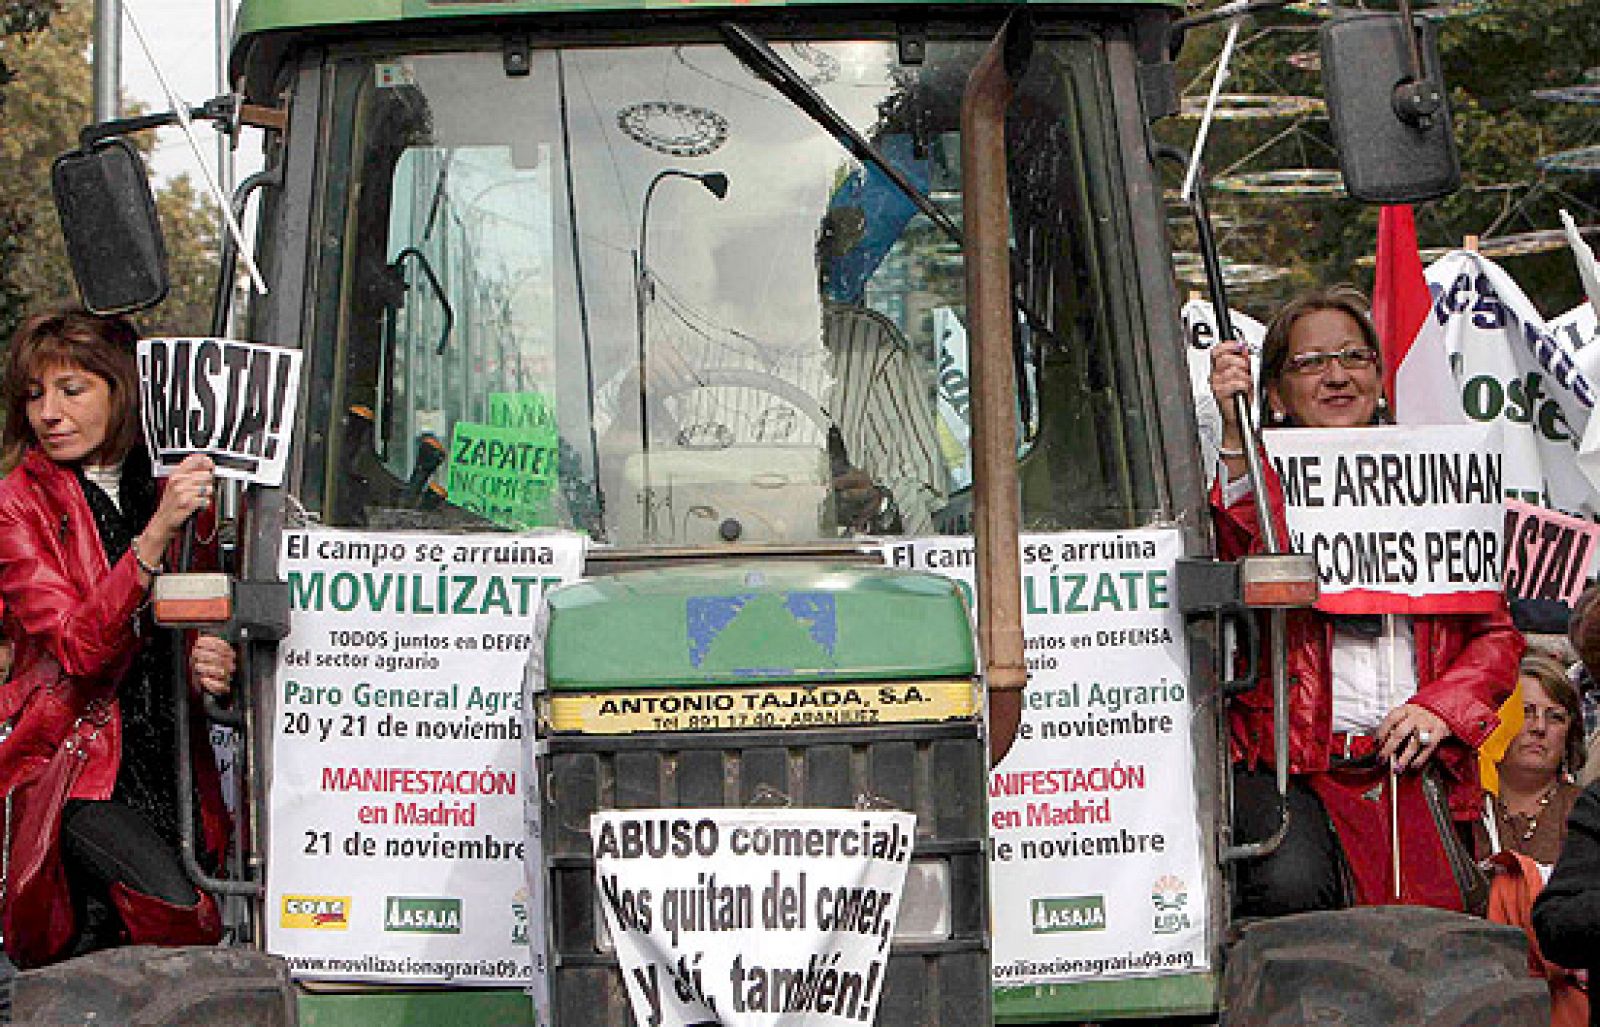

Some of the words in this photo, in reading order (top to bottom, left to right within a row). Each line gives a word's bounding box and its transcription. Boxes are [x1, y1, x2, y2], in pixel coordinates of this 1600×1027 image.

[141, 340, 292, 461] ¡BASTA!
[1334, 453, 1501, 507] ARRUINAN
[287, 535, 309, 560] El
[317, 541, 405, 567] campo
[415, 543, 444, 564] se
[453, 541, 554, 565] arruina
[1024, 543, 1053, 563] se
[1062, 535, 1156, 562] arruina
[1312, 531, 1417, 586] COMES
[1425, 530, 1499, 583] PEOR
[328, 631, 388, 648] TODOS
[393, 632, 449, 652] juntos
[454, 637, 478, 650] en
[1071, 634, 1092, 650] en
[1096, 627, 1173, 647] DEFENSA
[284, 652, 310, 667] del
[316, 653, 368, 668] sector
[375, 653, 440, 672] agrario
[284, 680, 342, 706] Paro
[354, 683, 458, 710] General
[599, 694, 734, 716] ANTONIO
[878, 686, 931, 704] S.A.
[1088, 678, 1185, 713] Agrario
[284, 713, 310, 735] 20
[319, 719, 333, 742] y
[340, 715, 366, 738] 21
[377, 716, 407, 738] de
[1041, 711, 1173, 740] noviembre
[321, 765, 516, 795] MANIFESTACIÓN
[358, 804, 388, 824] en
[395, 800, 476, 827] Madrid
[992, 810, 1021, 829] en
[1027, 797, 1112, 827] Madrid
[303, 831, 332, 855] 21
[343, 832, 376, 856] de
[386, 832, 524, 860] noviembre
[596, 818, 720, 859] ABUSO
[730, 821, 909, 862] comercial:
[1021, 829, 1165, 860] noviembre
[662, 873, 753, 948] quitan
[762, 870, 807, 932] del
[633, 963, 662, 1025] y
